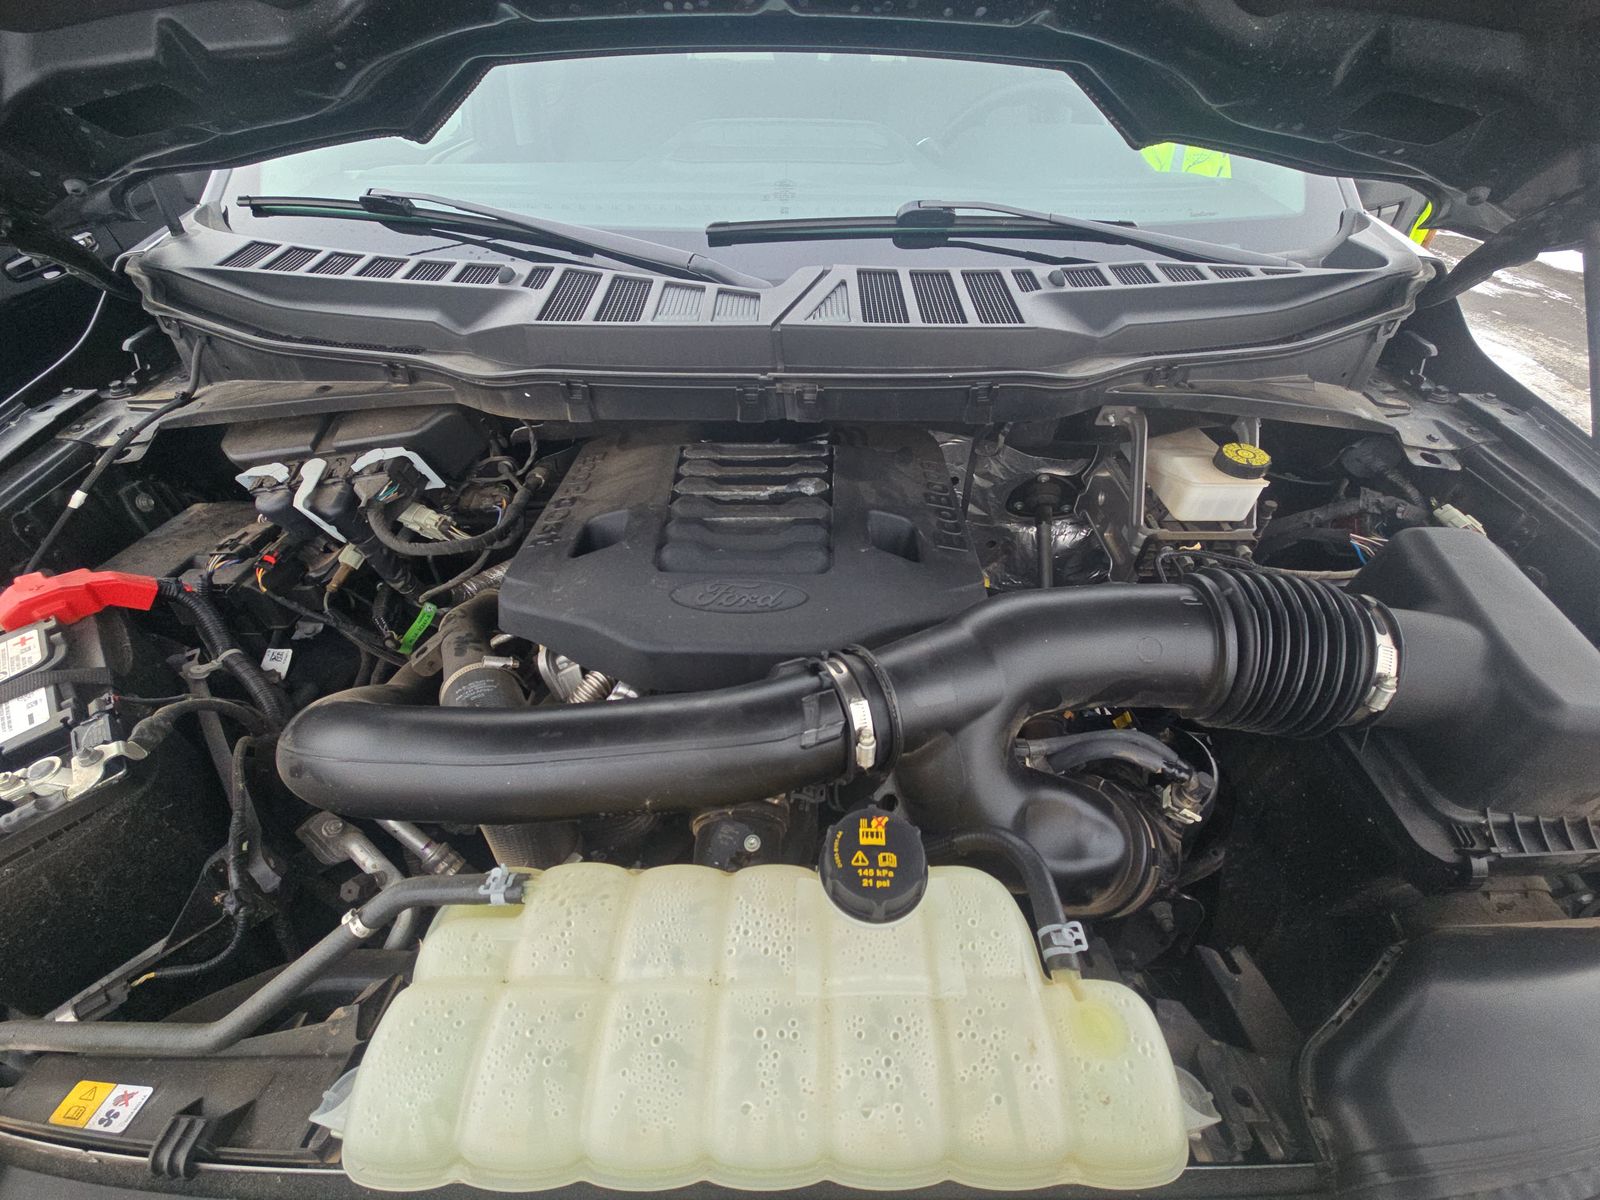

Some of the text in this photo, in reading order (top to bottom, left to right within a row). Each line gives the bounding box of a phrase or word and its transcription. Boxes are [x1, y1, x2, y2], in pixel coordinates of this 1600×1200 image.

[696, 582, 786, 608] Ford
[875, 868, 895, 878] kPa
[861, 878, 873, 887] 21
